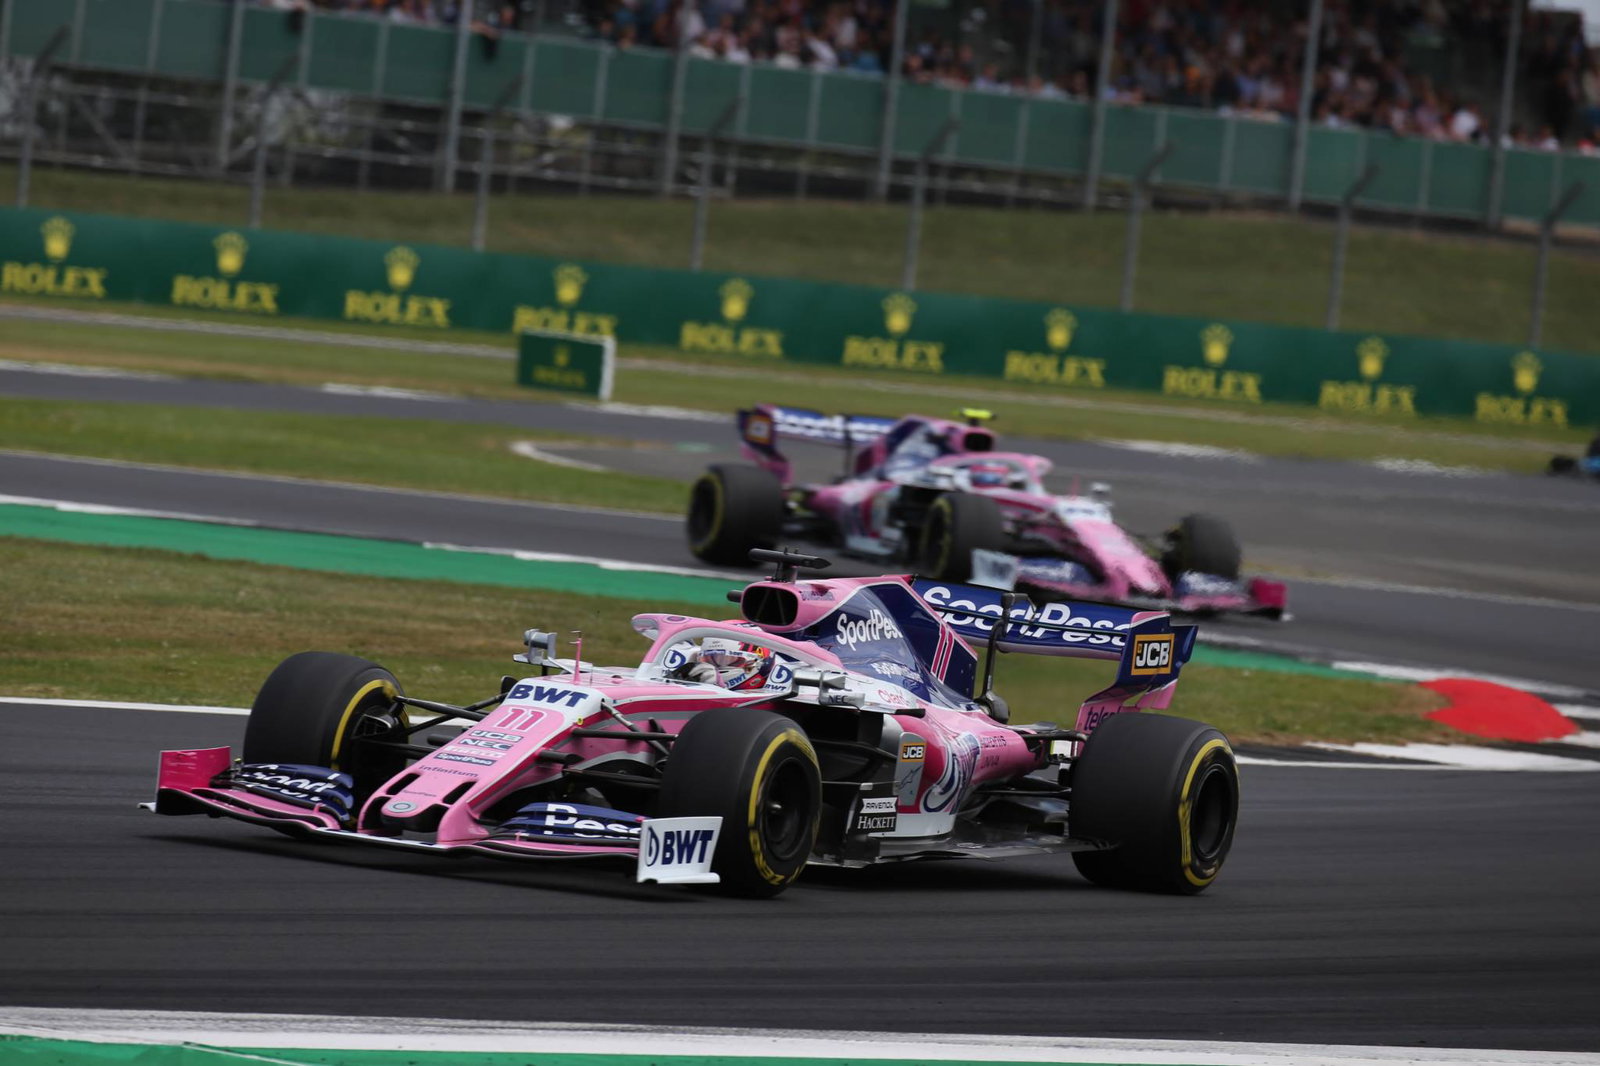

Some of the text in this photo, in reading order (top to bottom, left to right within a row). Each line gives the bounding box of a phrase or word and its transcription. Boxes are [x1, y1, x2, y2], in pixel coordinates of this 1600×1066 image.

[2, 261, 106, 298] ROLEX
[172, 275, 278, 314] ROLEX
[344, 290, 451, 329] ROLEX
[681, 322, 783, 357] ROLEX
[842, 335, 944, 373] ROLEX
[1004, 350, 1105, 387] ROLEX
[1163, 364, 1261, 403] ROLEX
[1135, 642, 1170, 667] JCB
[508, 684, 588, 707] BWT
[829, 695, 849, 704] NEC
[496, 707, 547, 732] 11
[459, 738, 513, 750] NEC
[471, 730, 523, 742] JCB
[903, 745, 924, 759] JCB
[419, 764, 479, 778] infinitum
[865, 801, 894, 811] RAVENOL
[857, 814, 896, 830] HACKETT
[661, 829, 714, 865] BWT
